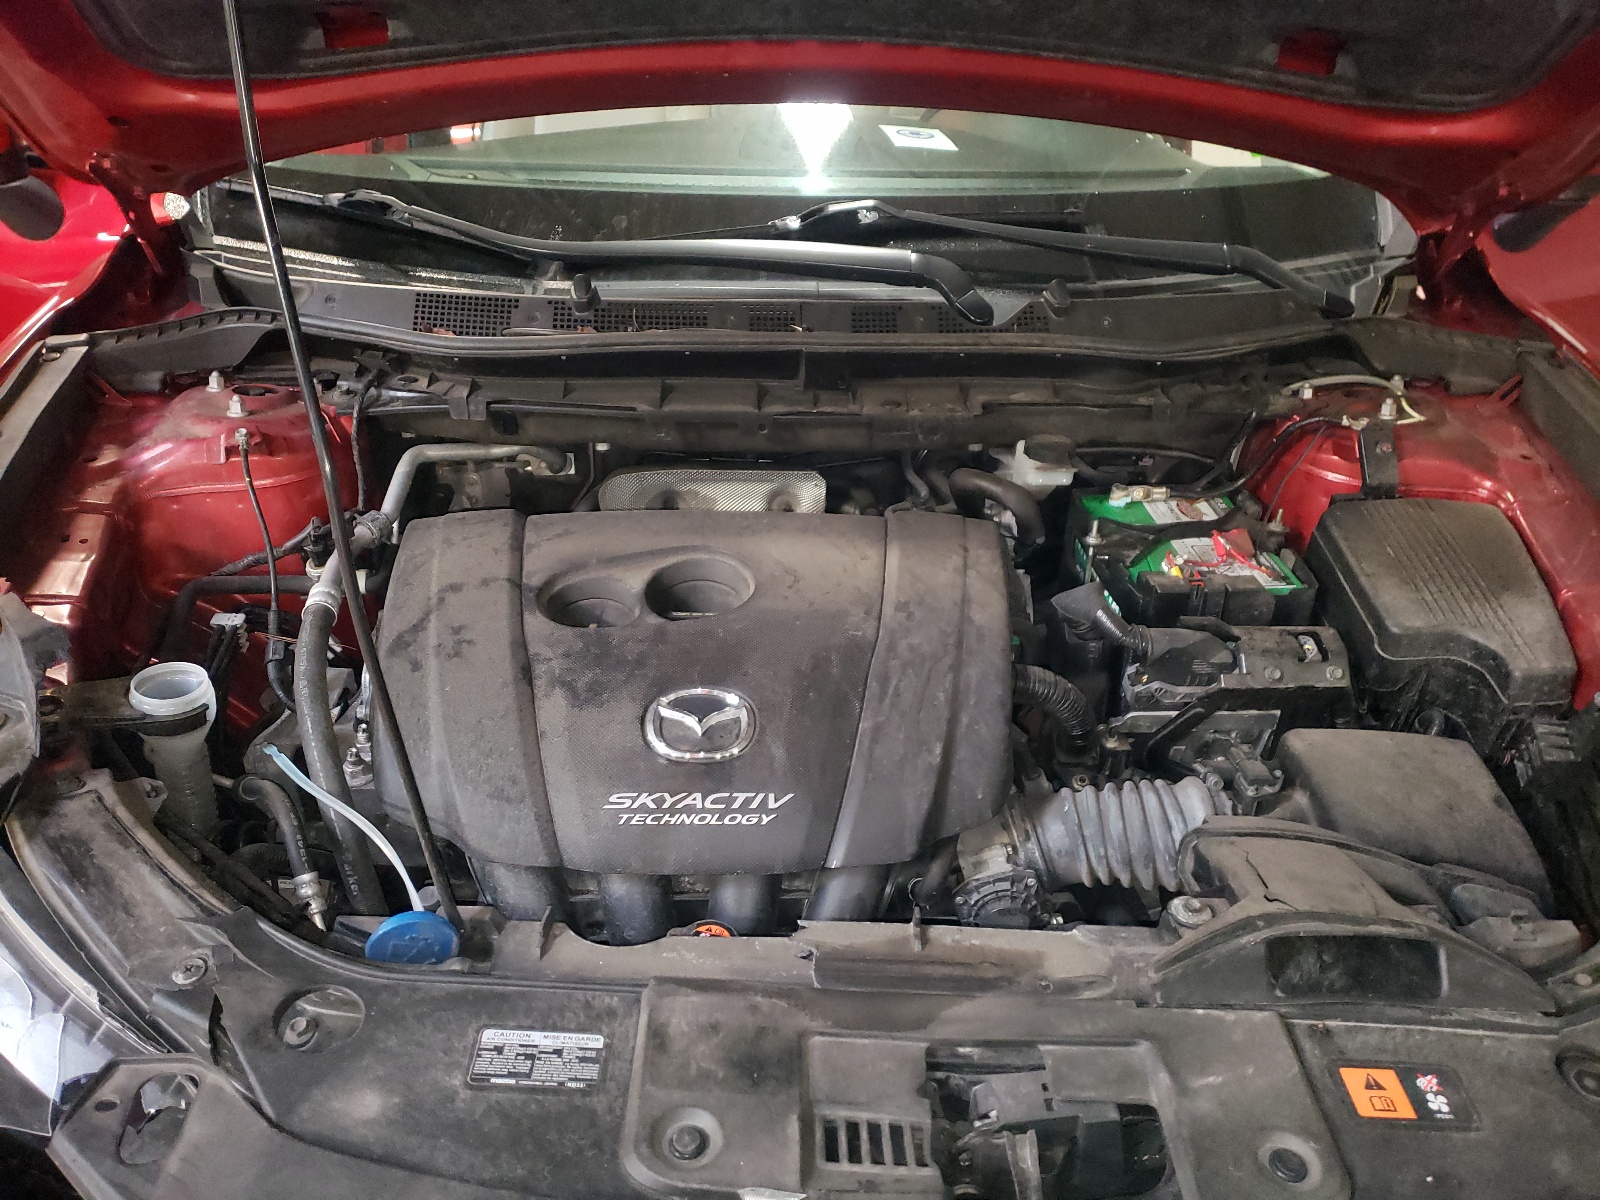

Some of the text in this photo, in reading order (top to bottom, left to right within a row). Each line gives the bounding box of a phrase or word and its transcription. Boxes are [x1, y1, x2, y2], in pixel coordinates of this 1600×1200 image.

[602, 792, 796, 809] SKYACTIV
[618, 813, 778, 826] TECHNOLOGY
[493, 1031, 532, 1039] CAUTION
[574, 1035, 601, 1043] GARDE
